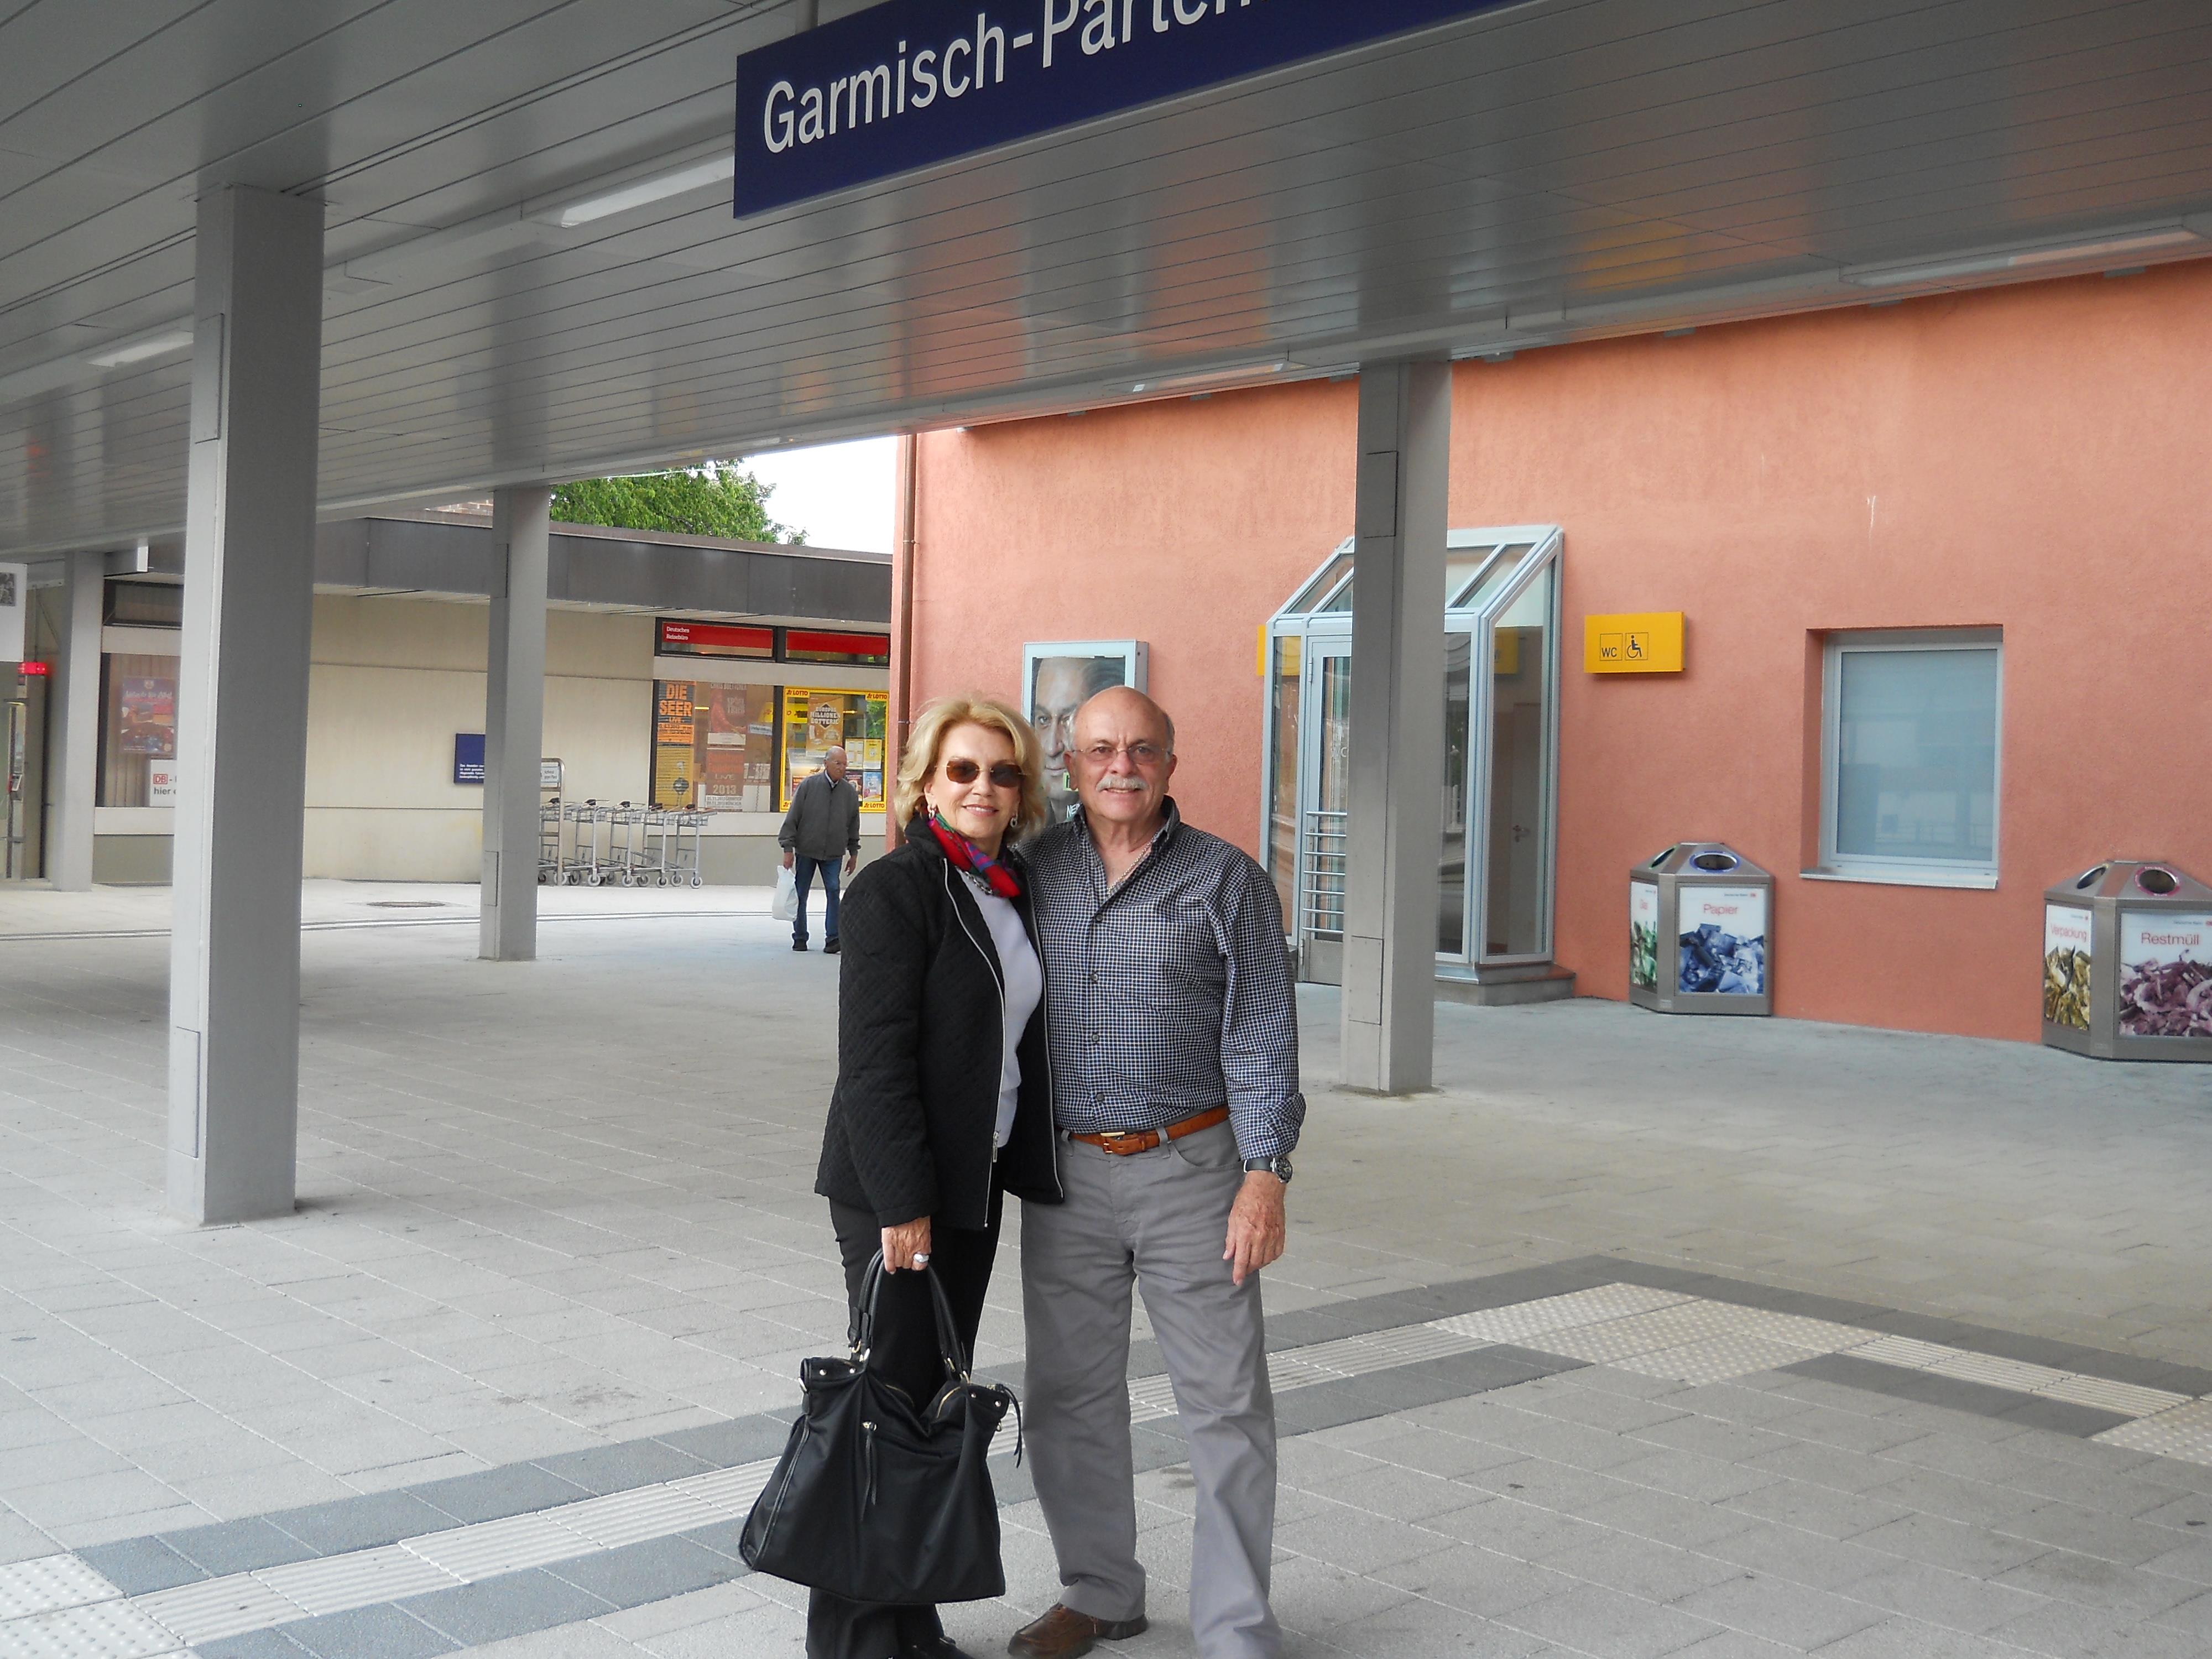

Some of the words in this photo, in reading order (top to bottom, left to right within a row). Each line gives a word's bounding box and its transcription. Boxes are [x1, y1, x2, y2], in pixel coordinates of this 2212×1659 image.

[1601, 648, 1617, 658] WC
[666, 684, 687, 700] DIE
[660, 700, 692, 717] SEER
[713, 784, 737, 795] 2013
[1704, 904, 1738, 916] Papier
[2050, 924, 2087, 942] Verpackung
[2141, 932, 2199, 945] Restmüll
